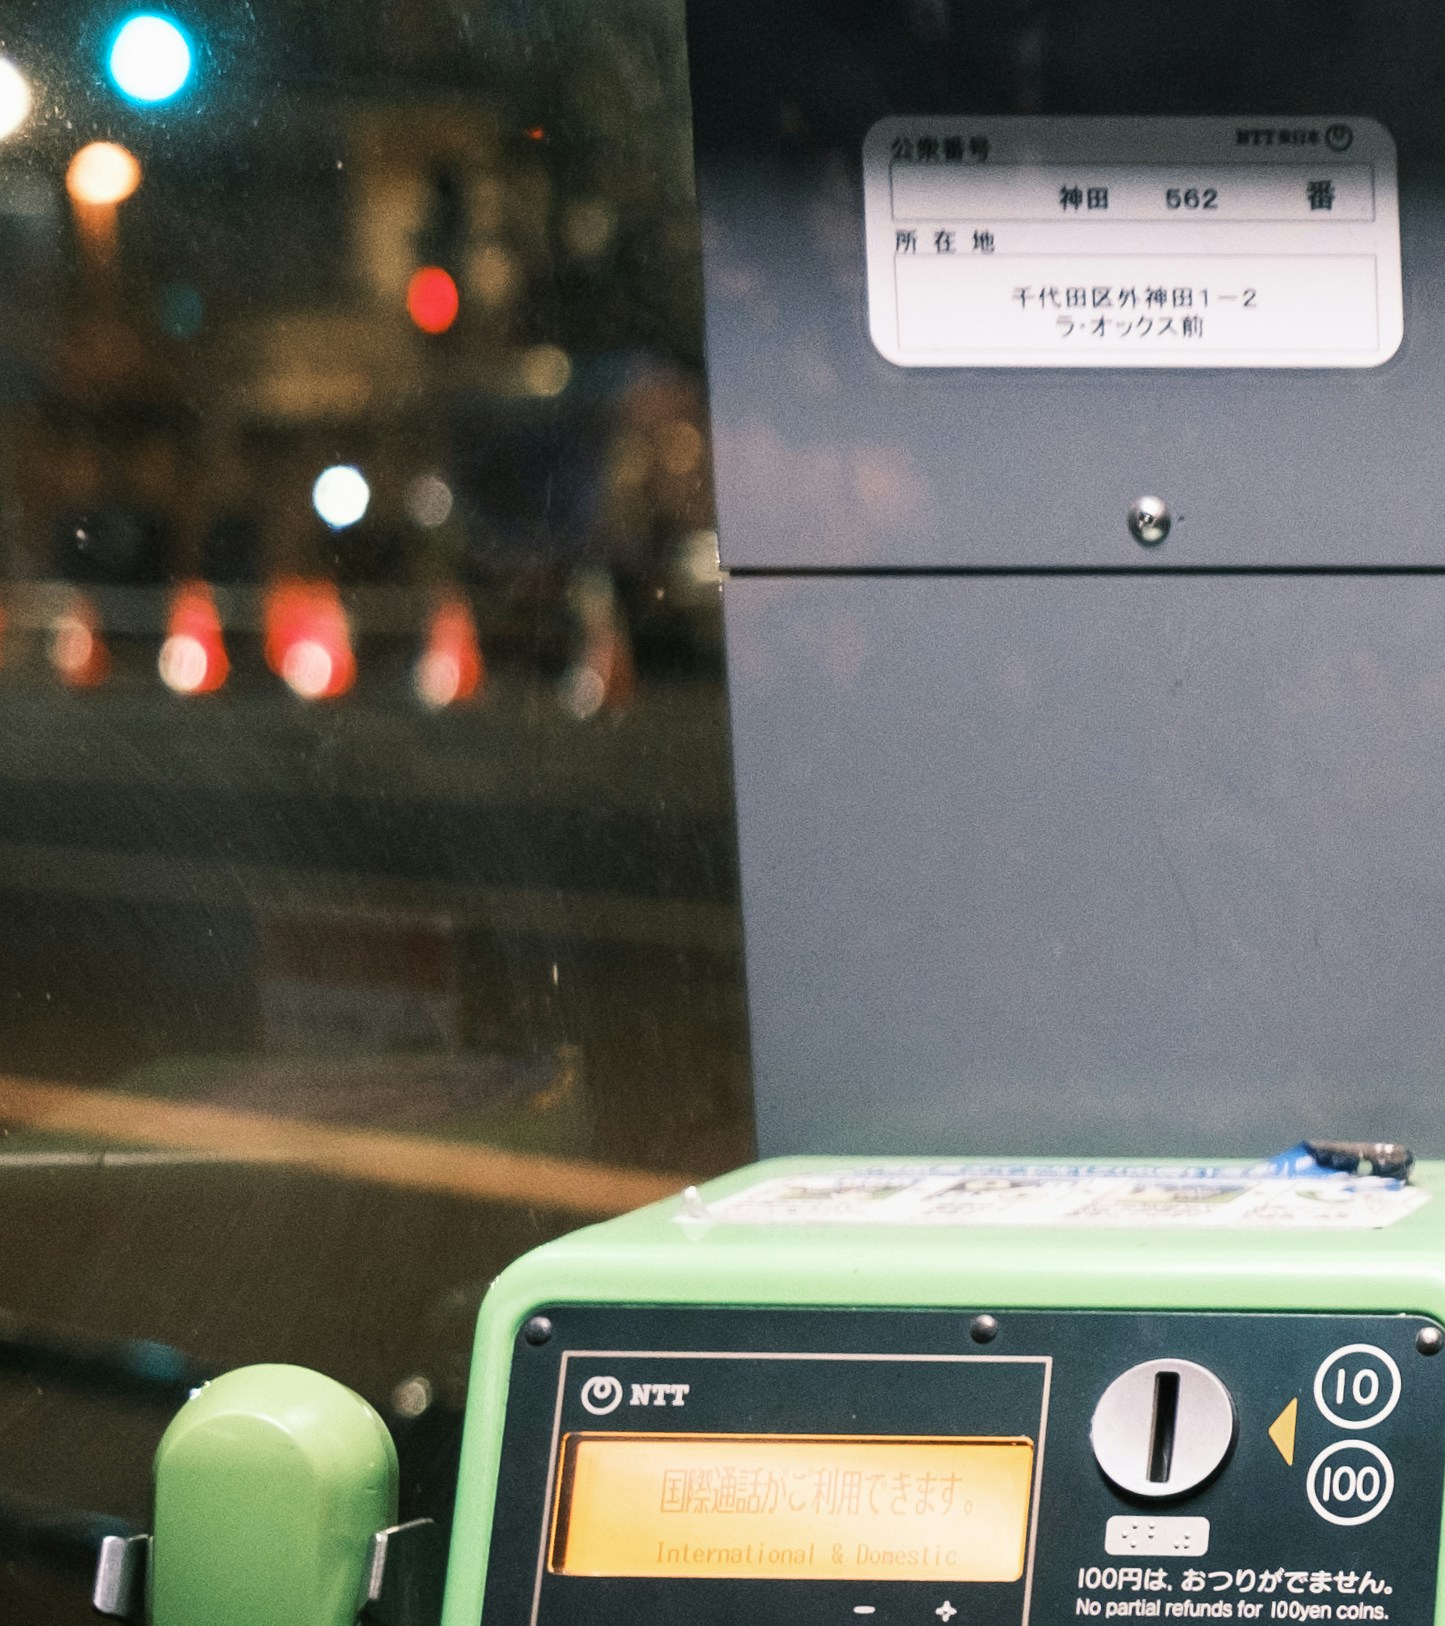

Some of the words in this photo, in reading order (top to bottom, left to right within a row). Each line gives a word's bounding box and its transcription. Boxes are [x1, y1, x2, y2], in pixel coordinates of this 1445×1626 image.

[1060, 186, 1109, 211] 神田
[1165, 188, 1218, 210] 562
[1306, 181, 1336, 211] 番
[628, 1384, 690, 1407] NTT
[1336, 1368, 1379, 1406] 10
[1323, 1465, 1380, 1502] 100
[656, 1541, 816, 1566] International
[831, 1544, 844, 1565] &
[855, 1545, 958, 1567] Domestic
[1075, 1598, 1102, 1616] No
[1105, 1598, 1160, 1619] partial
[1165, 1599, 1232, 1618] refunds
[1237, 1600, 1263, 1618] for
[1270, 1602, 1332, 1621] 100yen
[1336, 1602, 1389, 1620] coins.
